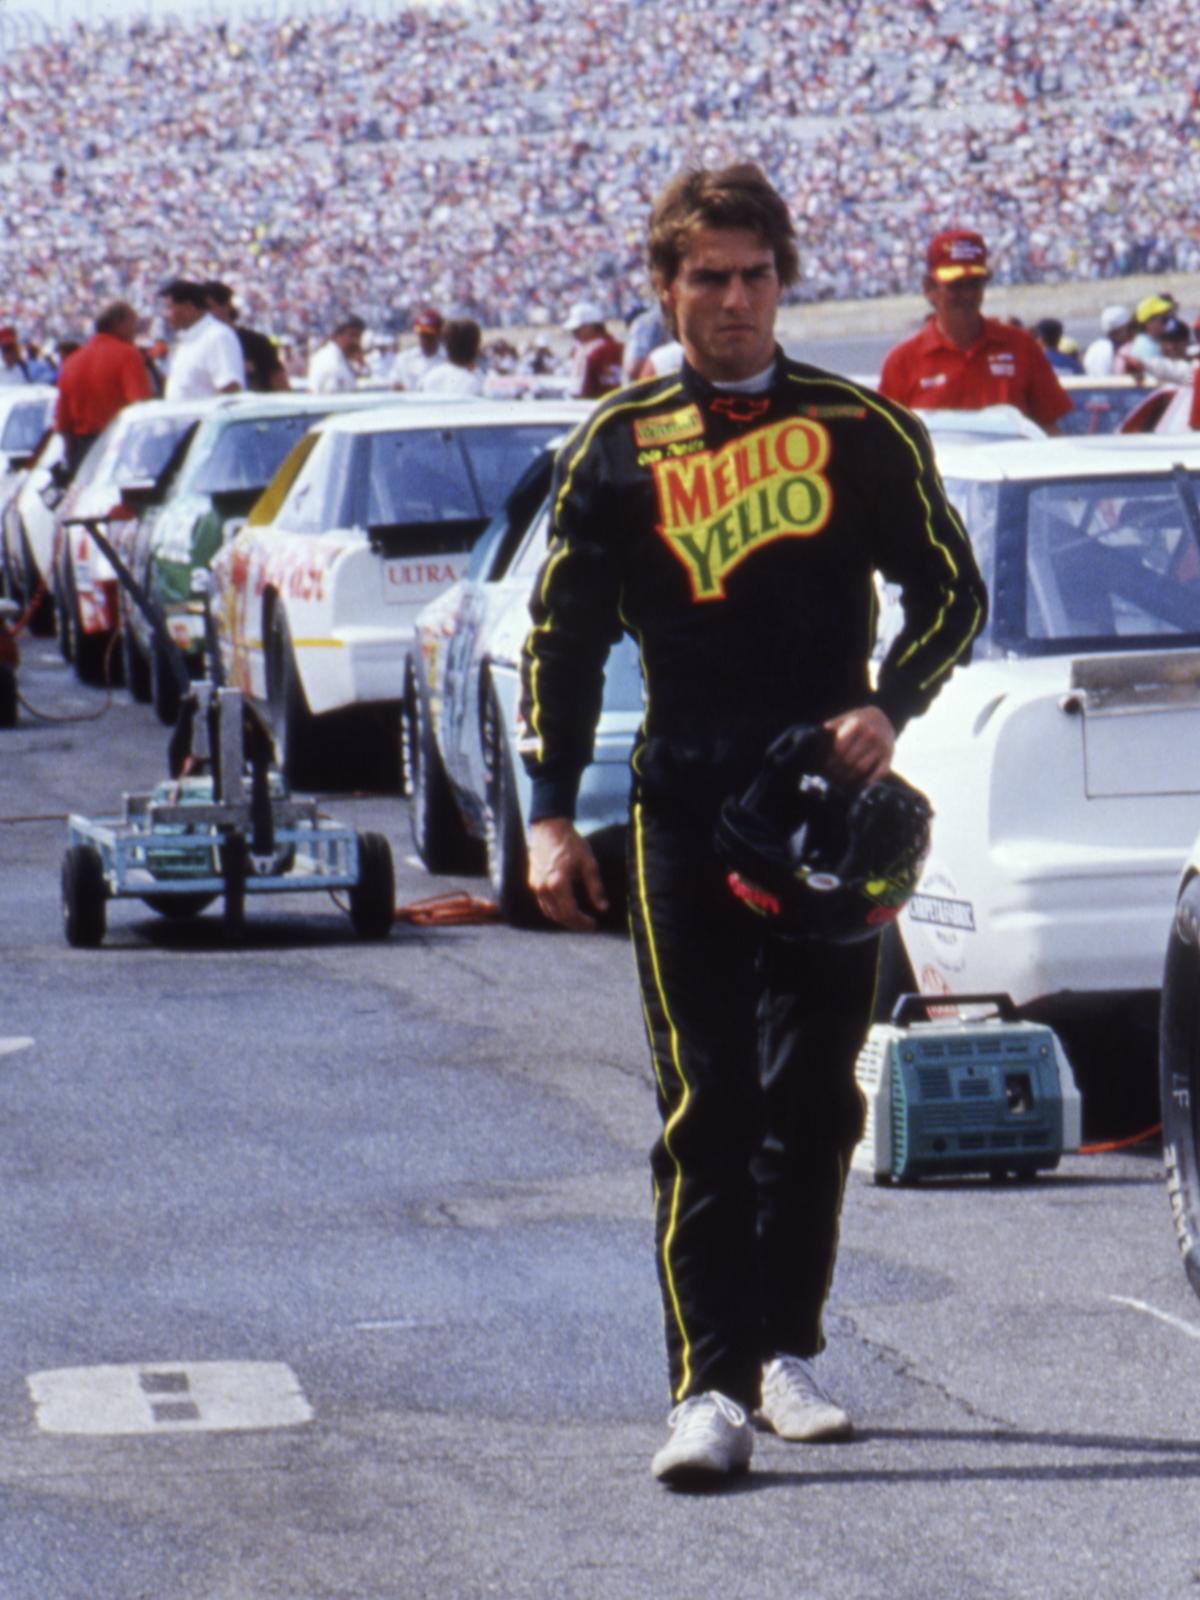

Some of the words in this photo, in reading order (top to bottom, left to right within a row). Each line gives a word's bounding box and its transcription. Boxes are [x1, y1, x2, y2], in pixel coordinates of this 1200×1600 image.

[663, 423, 820, 527] MELLO
[388, 562, 457, 585] ULTRA
[676, 477, 822, 591] YELLO
